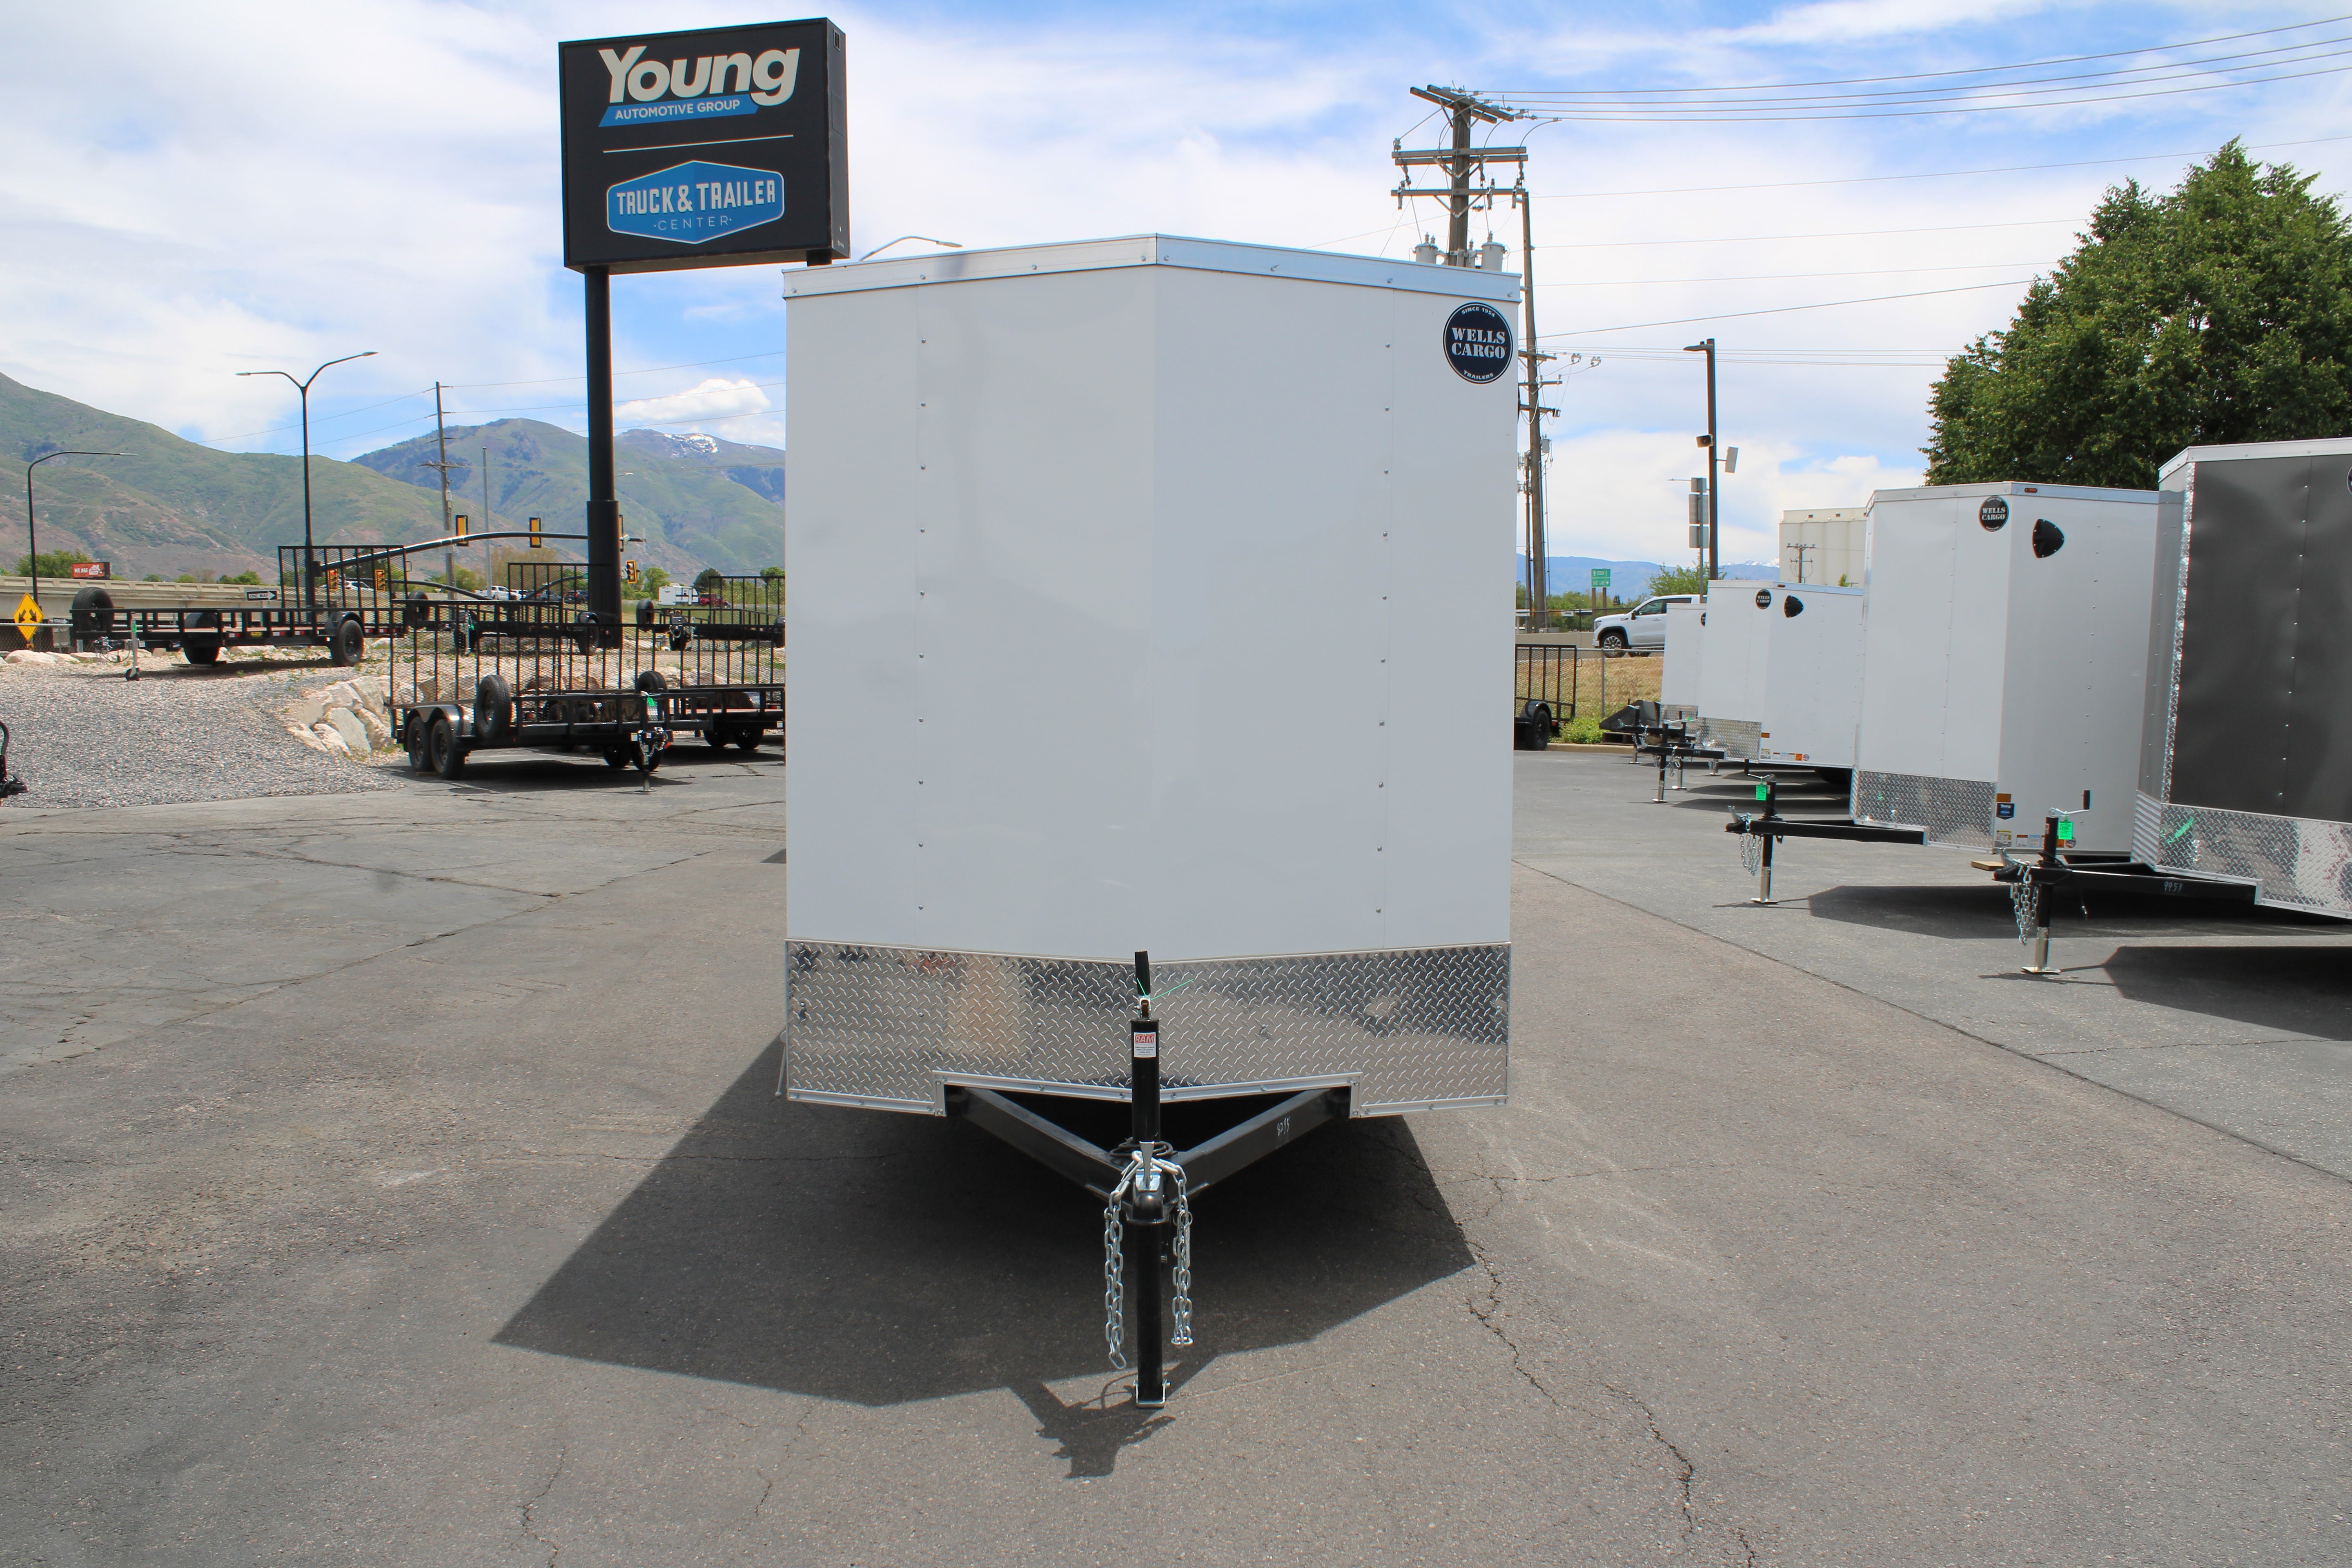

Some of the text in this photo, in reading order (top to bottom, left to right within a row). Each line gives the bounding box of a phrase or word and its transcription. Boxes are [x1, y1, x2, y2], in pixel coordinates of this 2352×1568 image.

[598, 45, 800, 106] Young
[615, 99, 740, 120] AUTOMOTIVE GROUP
[616, 180, 776, 215] TRUCK & TRAILER
[1461, 307, 1495, 317] SINCE 1954
[1452, 327, 1506, 344] WELLS
[1451, 342, 1506, 359] CARGO
[1463, 370, 1494, 380] TRAILERS
[1277, 1116, 1290, 1136] 8295
